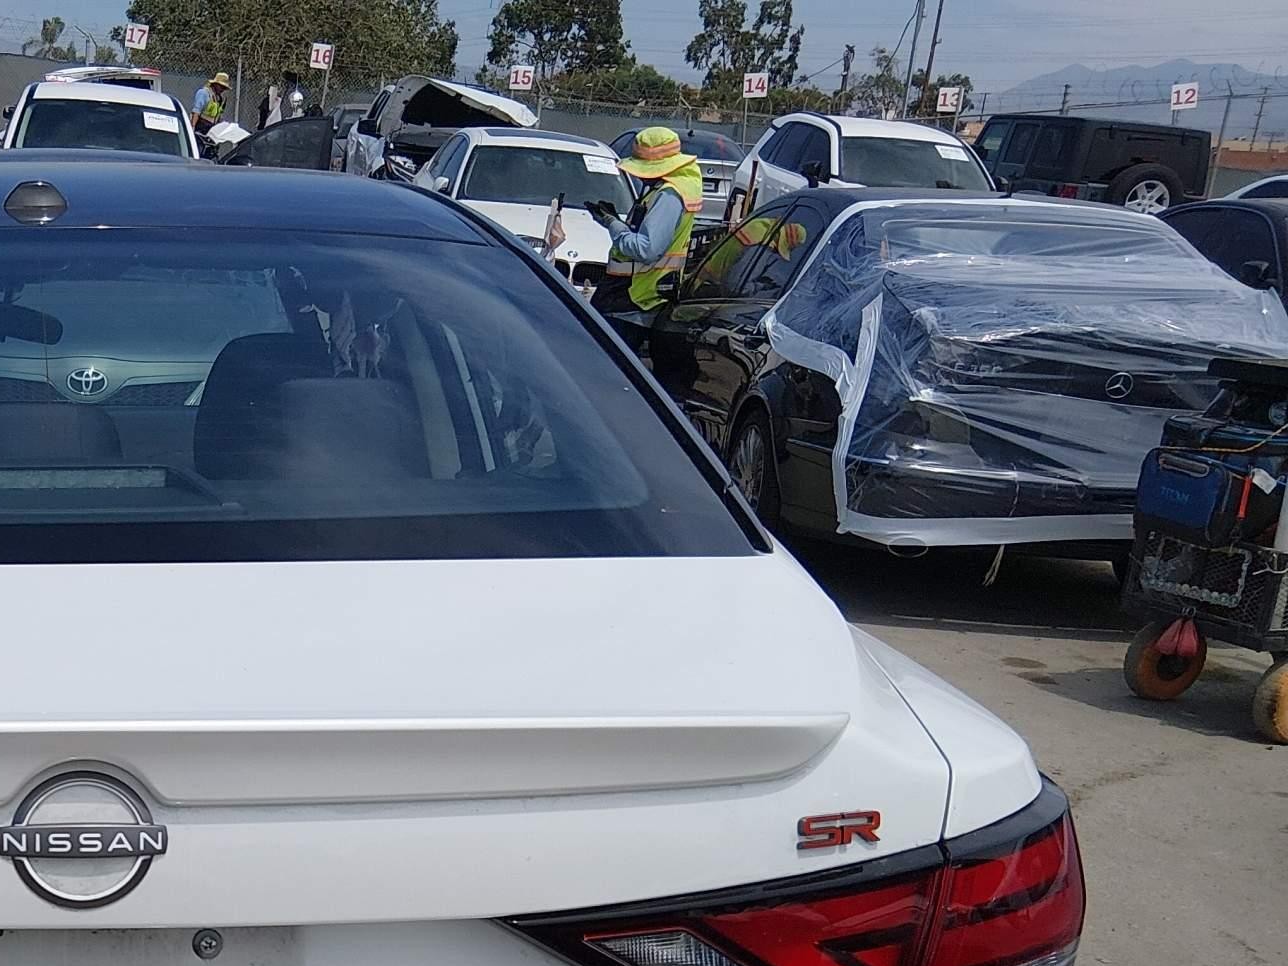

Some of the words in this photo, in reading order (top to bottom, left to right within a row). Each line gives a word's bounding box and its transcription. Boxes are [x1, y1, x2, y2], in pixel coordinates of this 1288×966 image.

[127, 28, 147, 44] 17
[312, 49, 332, 65] 16
[511, 70, 532, 85] 15
[745, 77, 767, 93] 14
[939, 92, 960, 107] 13
[1173, 88, 1196, 105] 12
[797, 811, 880, 850] SR
[2, 832, 163, 853] NISSAN
